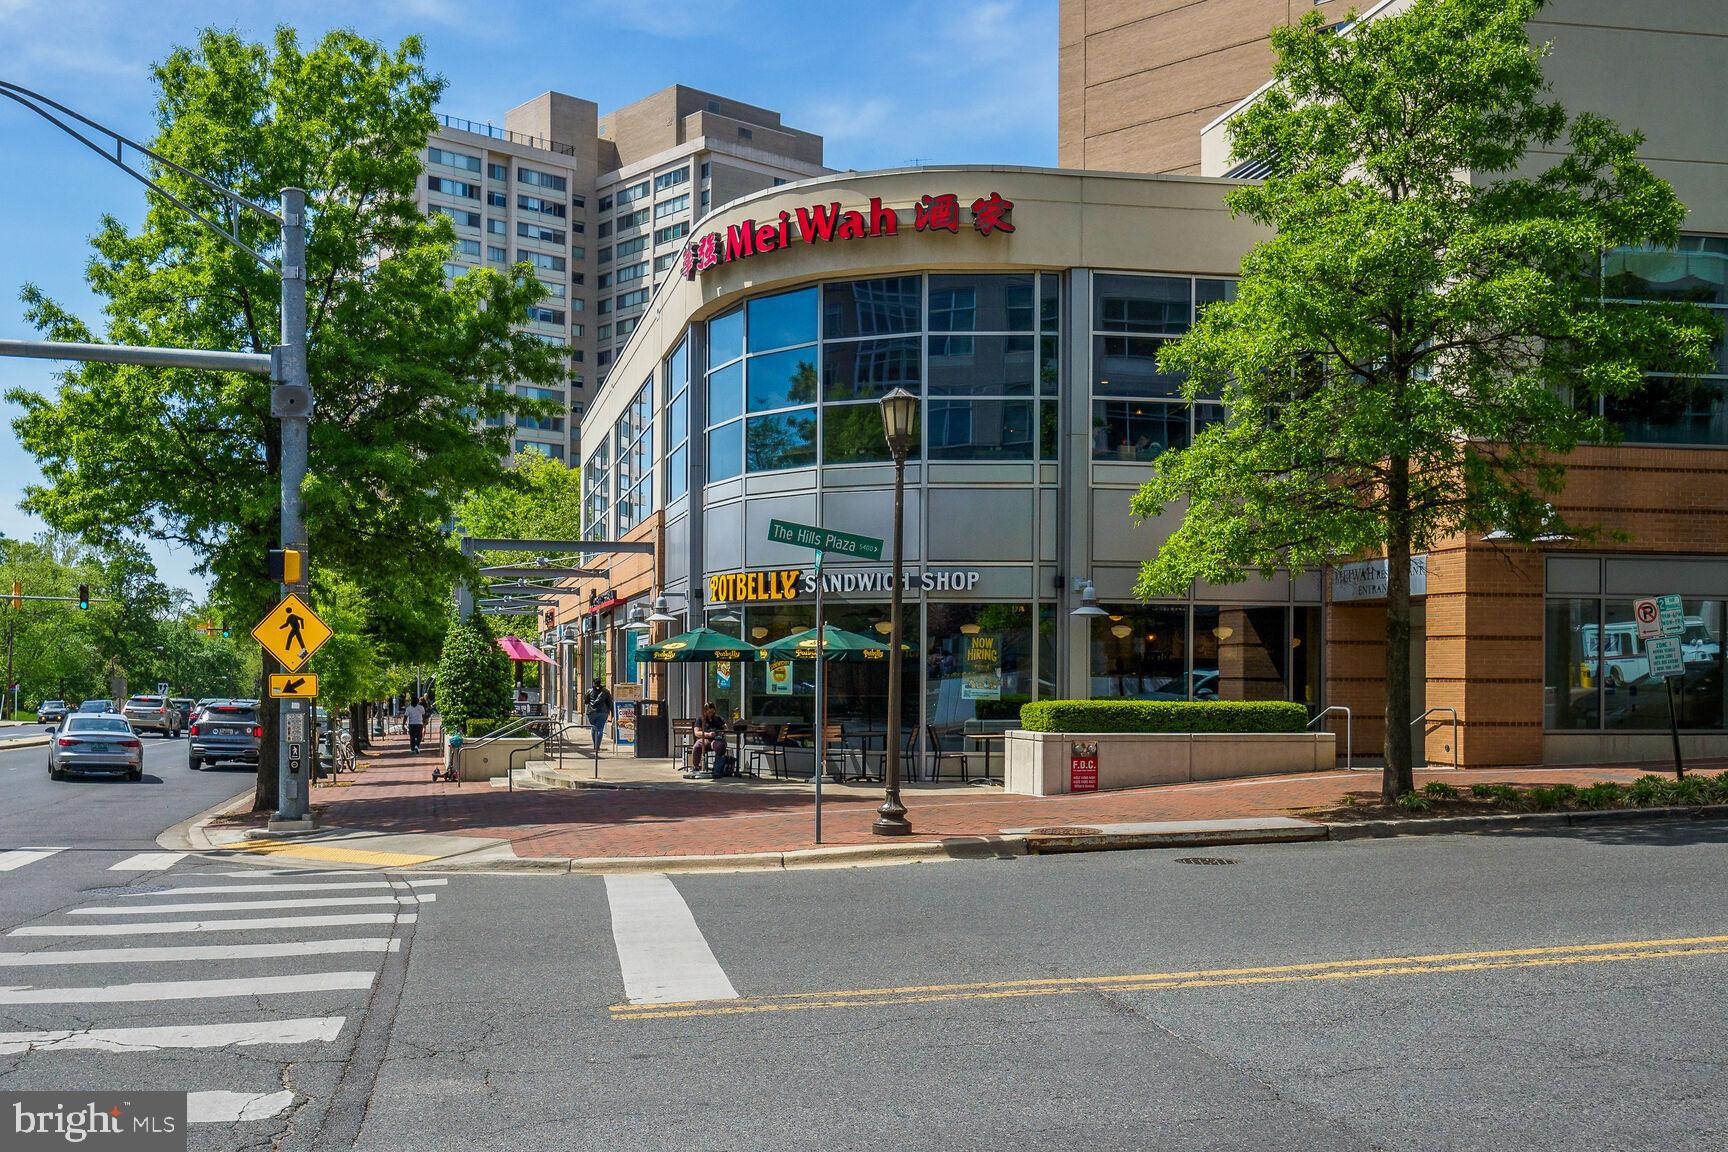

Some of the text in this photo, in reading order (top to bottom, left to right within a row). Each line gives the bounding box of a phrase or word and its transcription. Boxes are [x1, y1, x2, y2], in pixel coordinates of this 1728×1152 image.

[773, 524, 793, 541] The
[797, 528, 821, 546] Hills
[825, 534, 856, 552] Plaza
[708, 569, 801, 602] POTBELLY
[921, 571, 980, 592] SHOP
[972, 637, 994, 649] NOW
[967, 648, 998, 662] HIRING
[1073, 760, 1096, 769] F.D.C.
